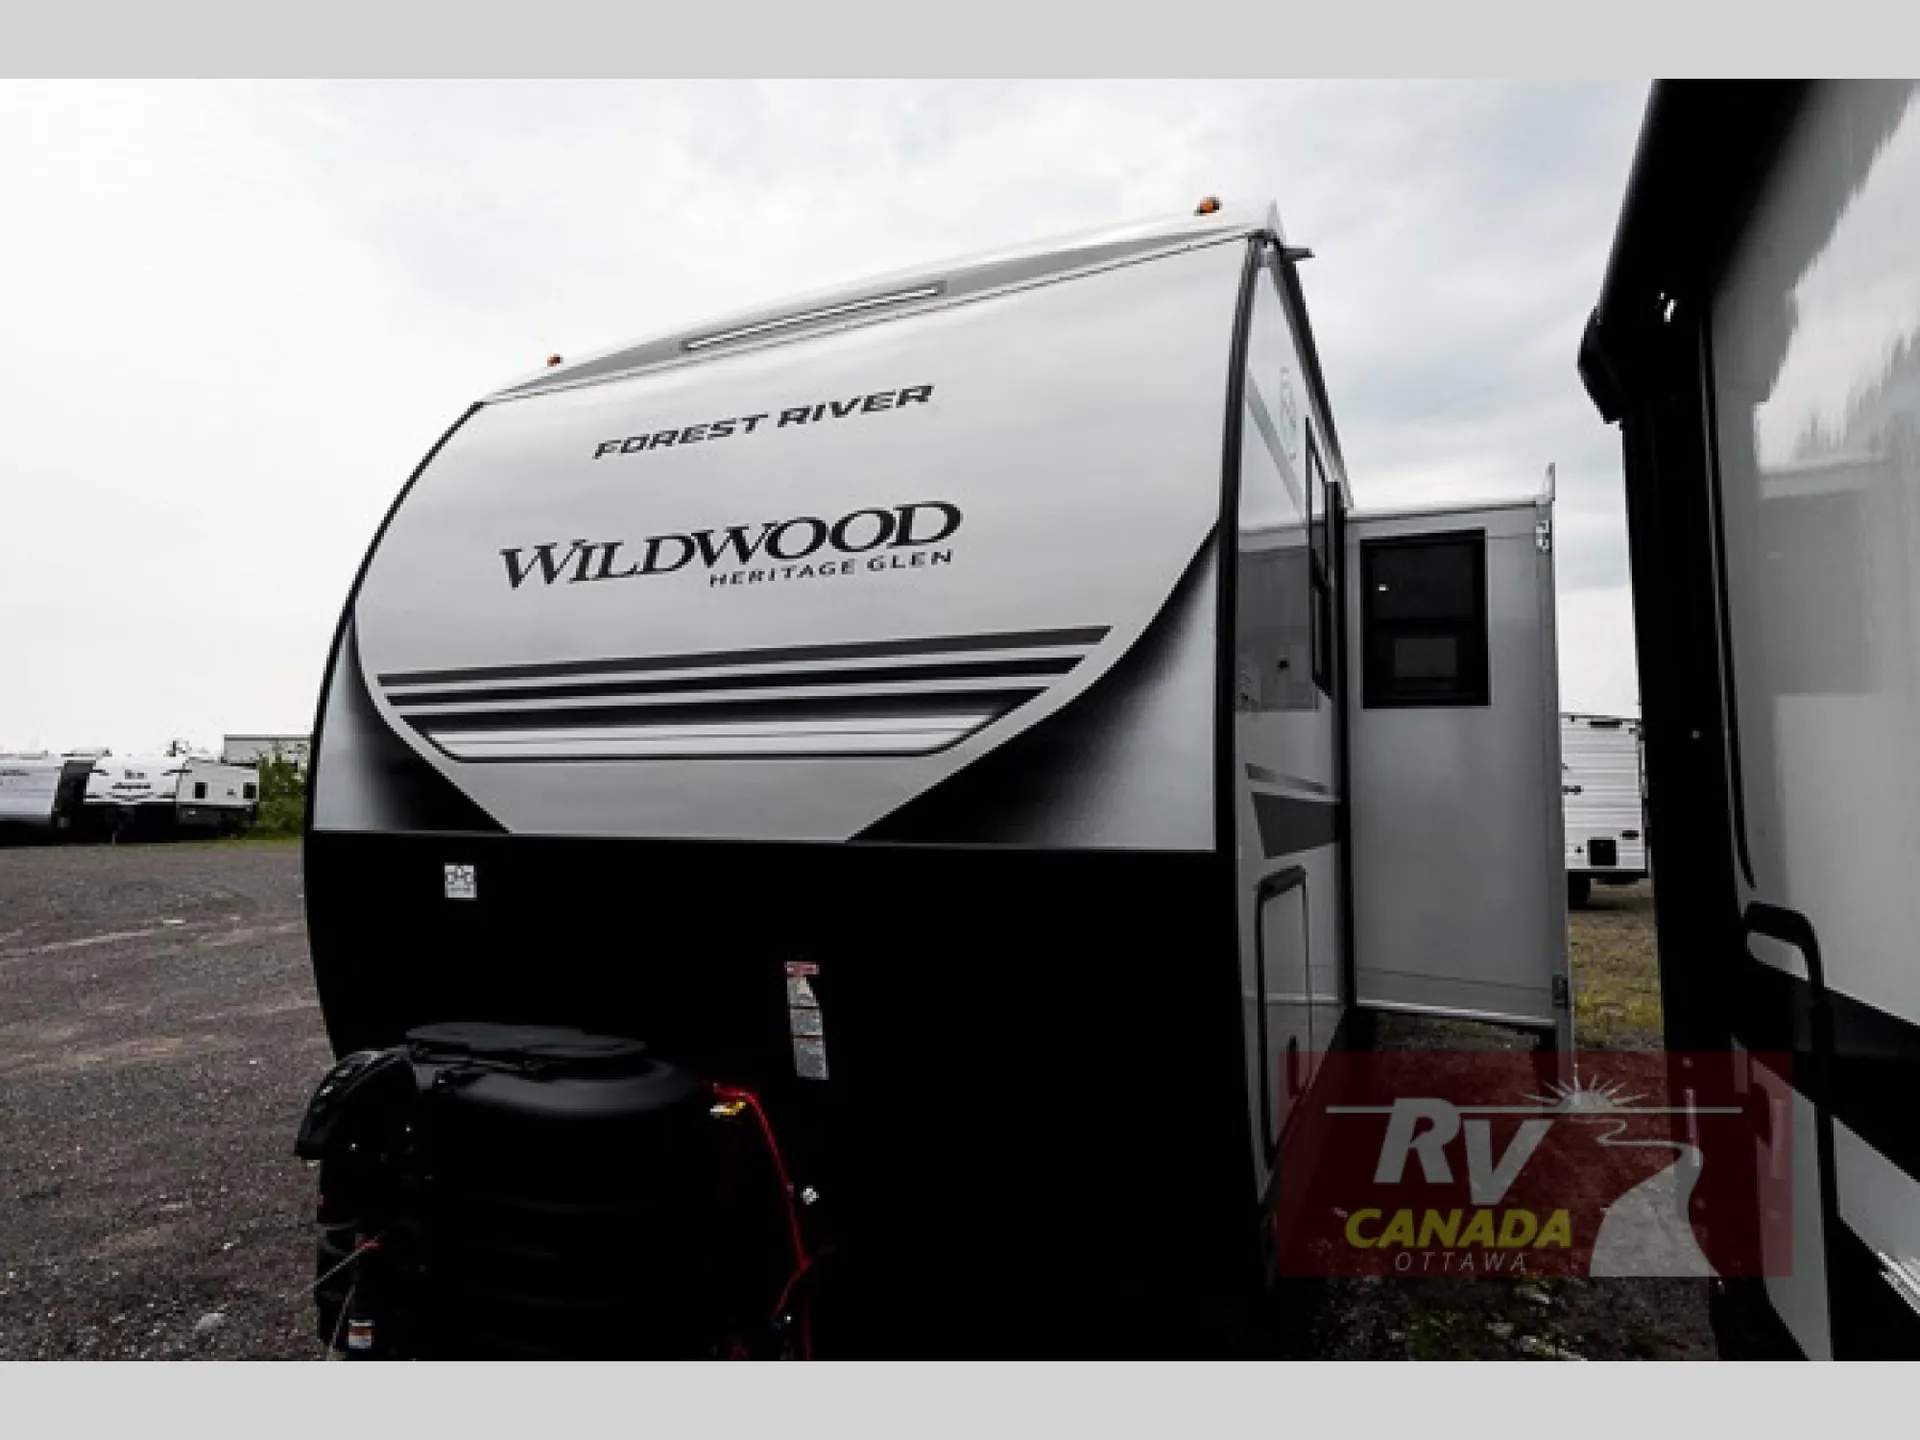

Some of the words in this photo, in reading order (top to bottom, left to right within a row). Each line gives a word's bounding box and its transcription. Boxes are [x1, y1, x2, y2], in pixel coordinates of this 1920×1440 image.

[593, 414, 769, 459] FOREST
[777, 385, 934, 428] RIVER
[500, 501, 962, 588] WILDWOOD
[709, 559, 856, 588] HERITAGE
[866, 549, 955, 574] GLEN
